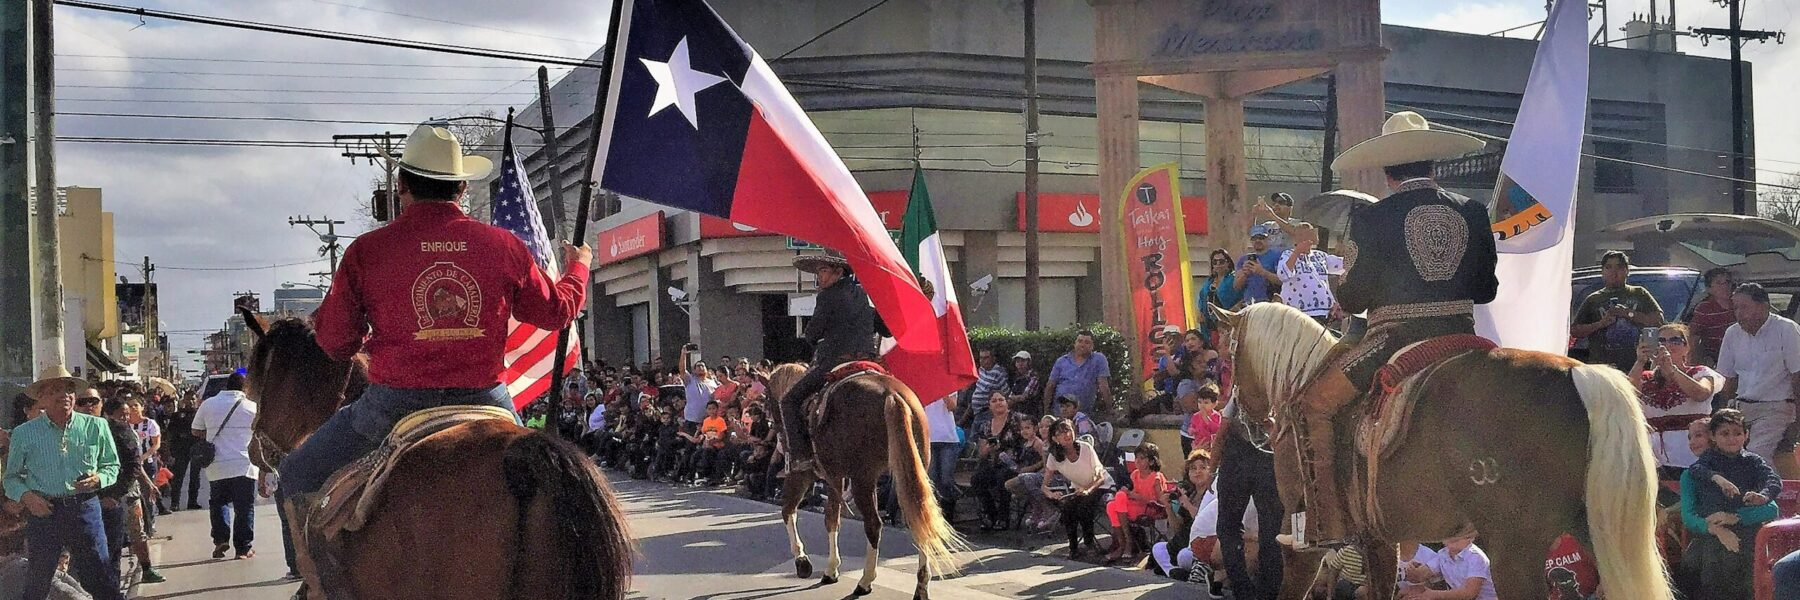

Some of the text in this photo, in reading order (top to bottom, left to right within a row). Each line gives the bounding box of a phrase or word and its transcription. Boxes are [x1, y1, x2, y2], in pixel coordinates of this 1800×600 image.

[421, 241, 468, 252] ENRIQUE
[415, 269, 443, 312] REGIMIENTO
[446, 269, 458, 279] DE
[1555, 552, 1581, 566] CALM
